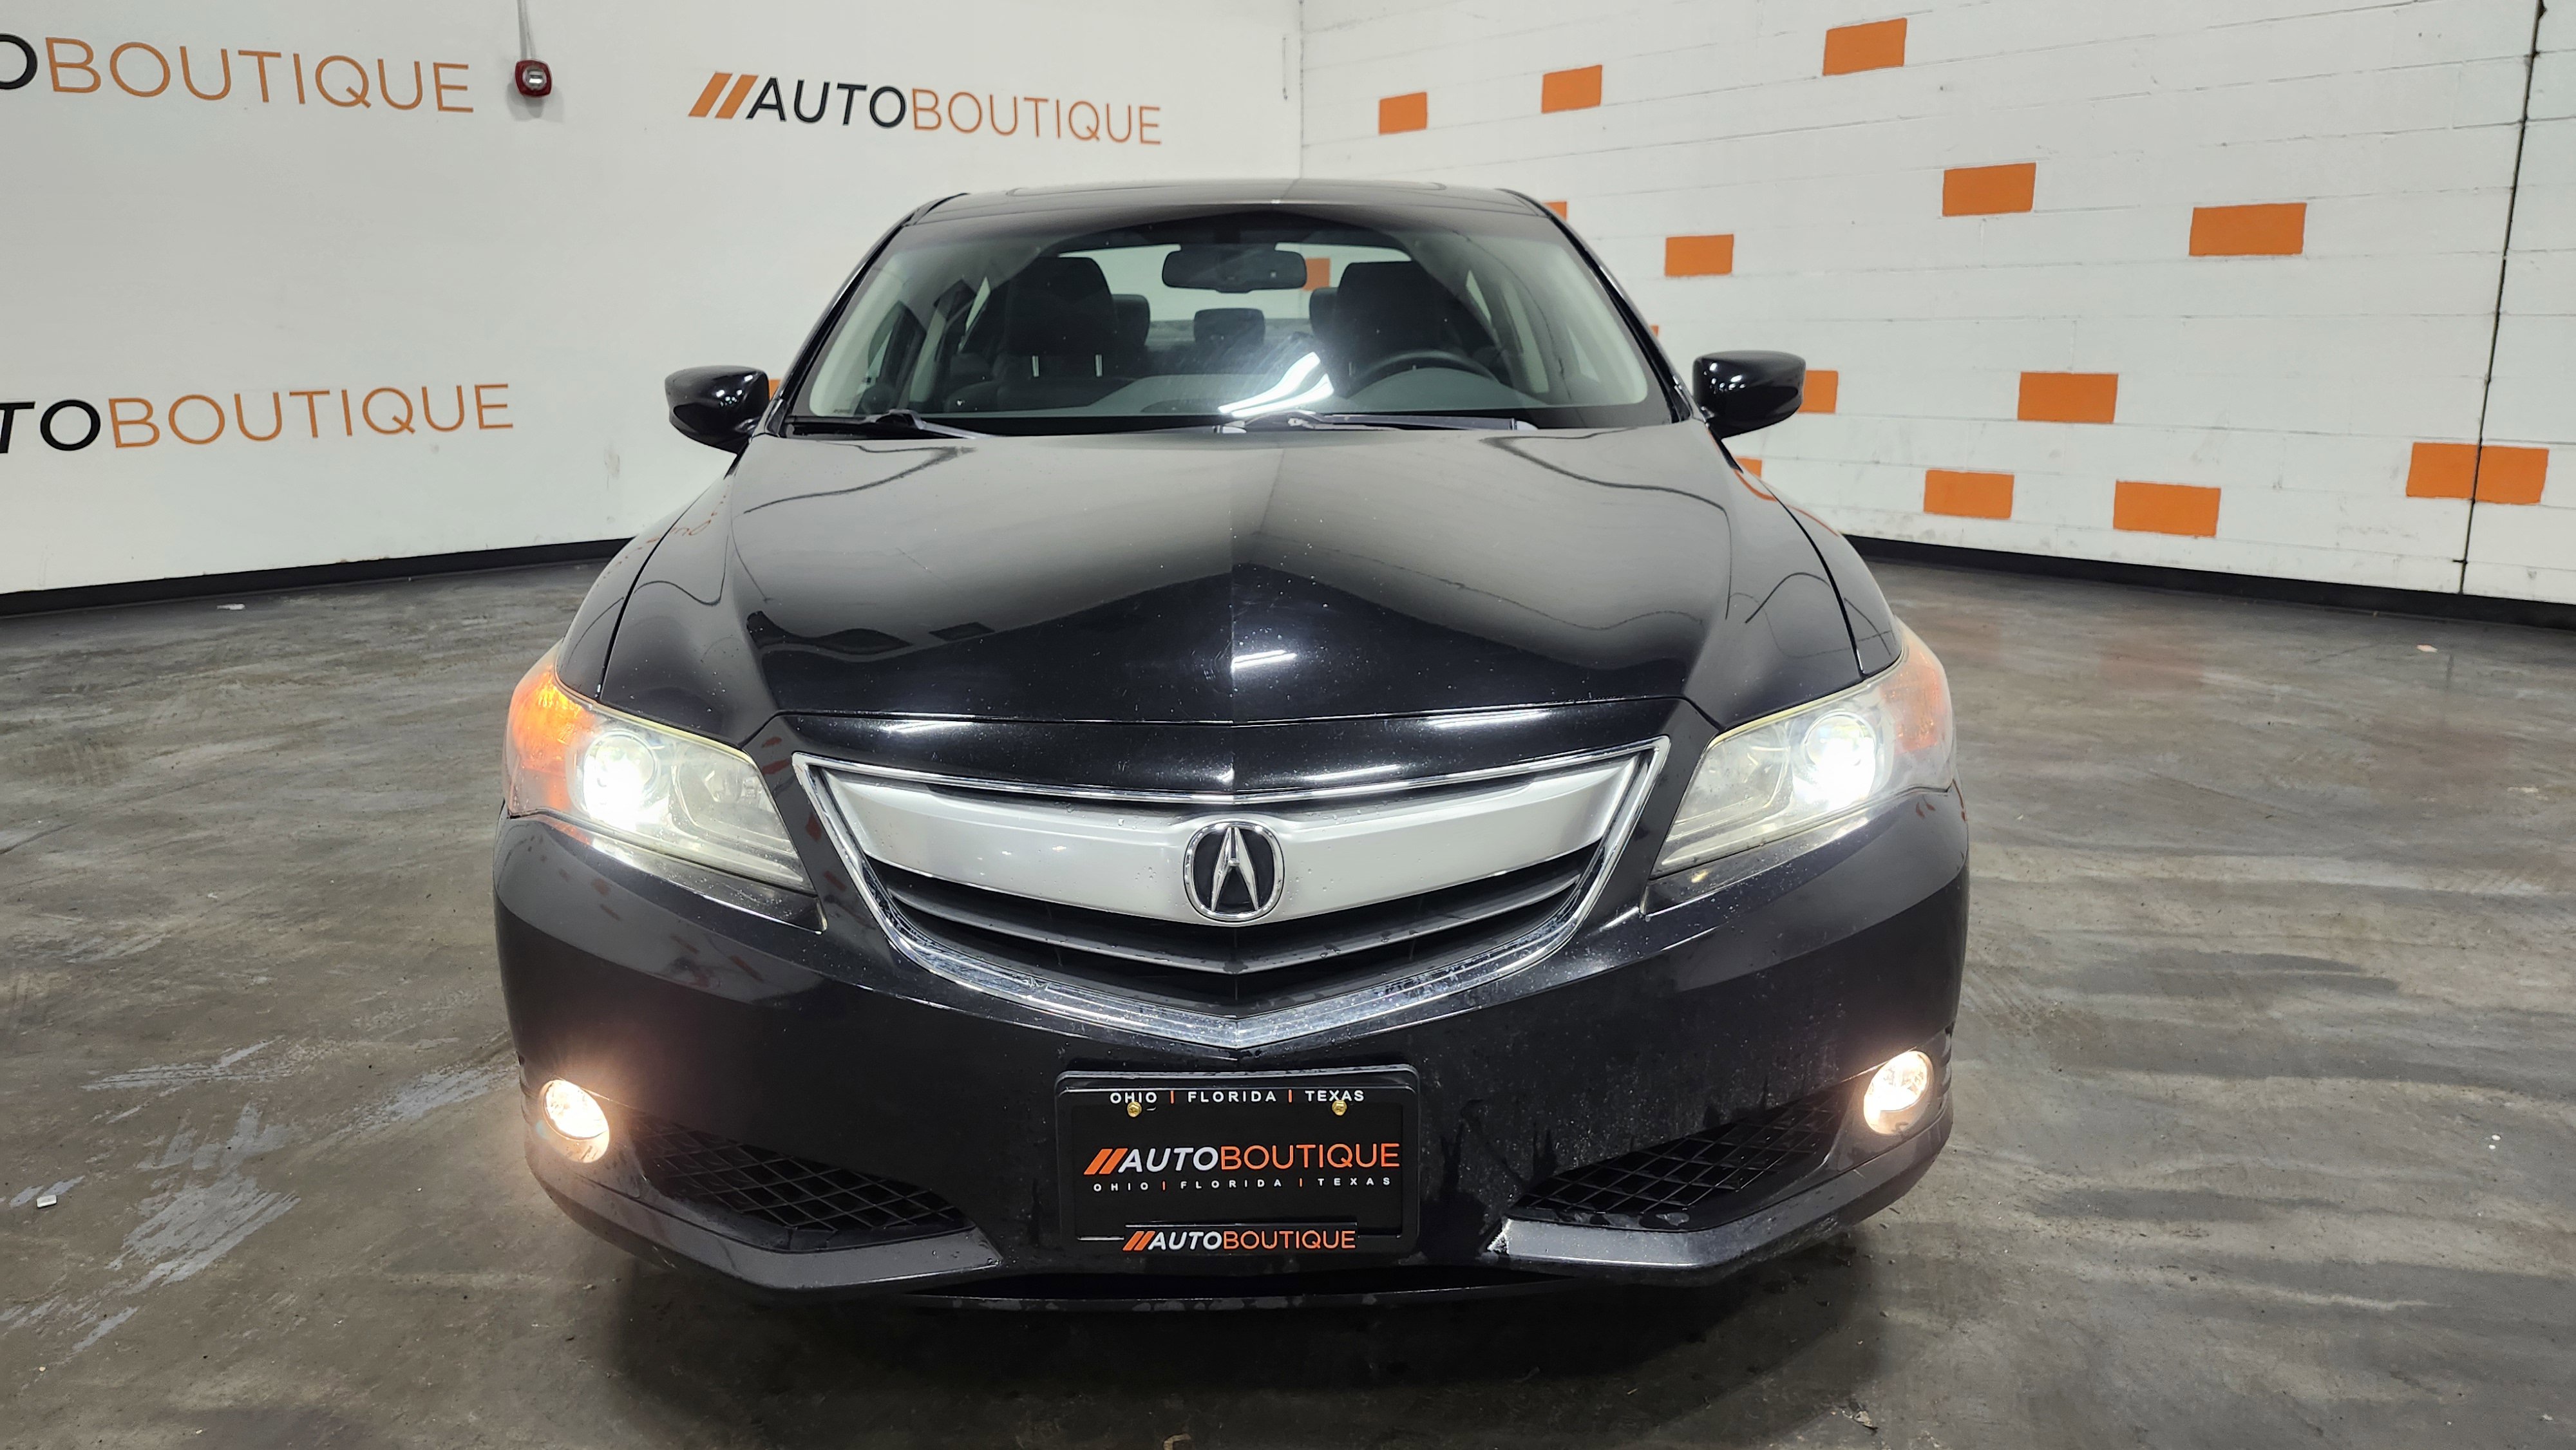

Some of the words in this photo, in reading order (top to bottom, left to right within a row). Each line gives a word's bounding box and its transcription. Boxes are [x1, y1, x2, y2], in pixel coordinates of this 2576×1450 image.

[746, 77, 1160, 145] AUTOBOUTIQUE
[1110, 1091, 1157, 1104] OHIO
[1188, 1090, 1277, 1103] FLORIDA
[1305, 1089, 1365, 1102] TEXAS
[1117, 1143, 1400, 1174] AUTOBOUTIQUE
[1093, 1182, 1149, 1192] OHIO
[1180, 1179, 1282, 1190] FLORIDA
[1317, 1177, 1391, 1187] TEXAS
[1148, 1230, 1356, 1251] AUTOBOUTIQUE
